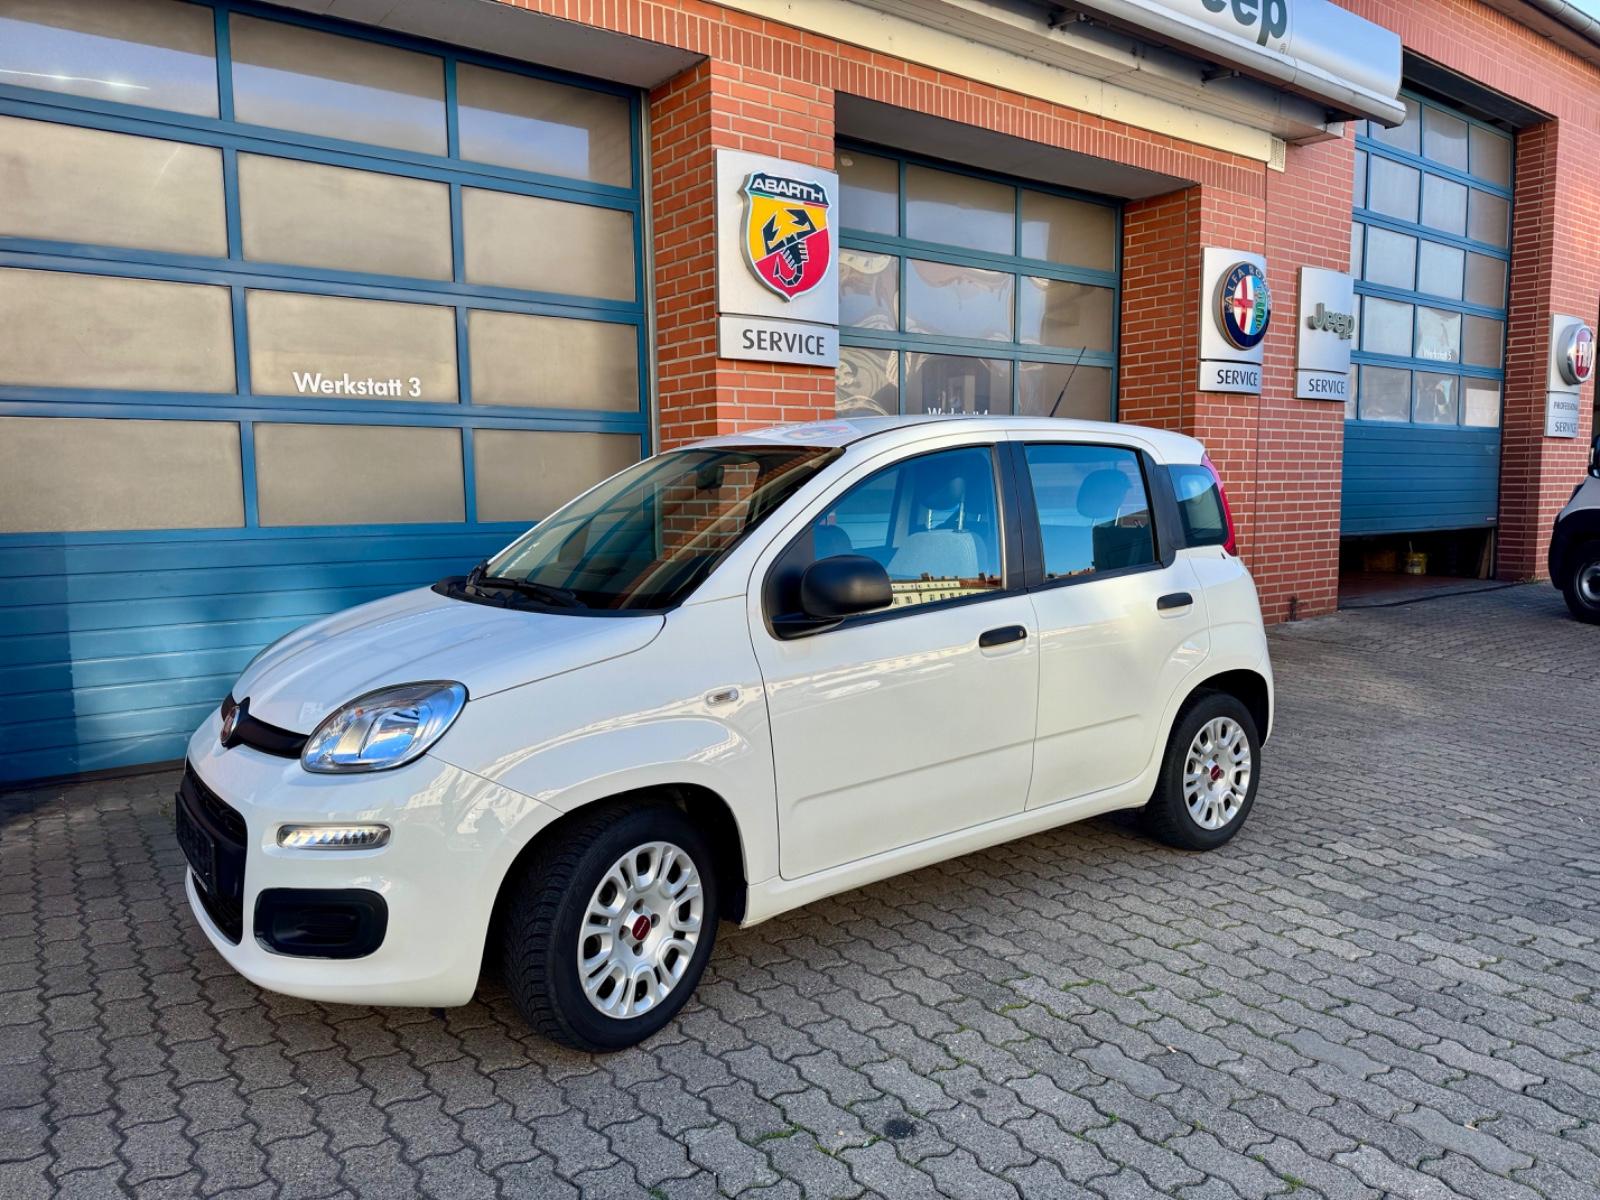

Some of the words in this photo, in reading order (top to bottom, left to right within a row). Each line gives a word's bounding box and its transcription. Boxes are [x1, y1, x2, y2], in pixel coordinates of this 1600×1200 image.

[752, 178, 824, 202] ABARTH
[1224, 268, 1246, 304] ALFA
[1307, 302, 1355, 339] Jeep
[742, 328, 825, 356] SERVICE
[292, 371, 402, 396] Werkstatt
[408, 377, 421, 397] 3
[1216, 369, 1258, 387] SERVICE
[1308, 378, 1345, 395] SERVICE
